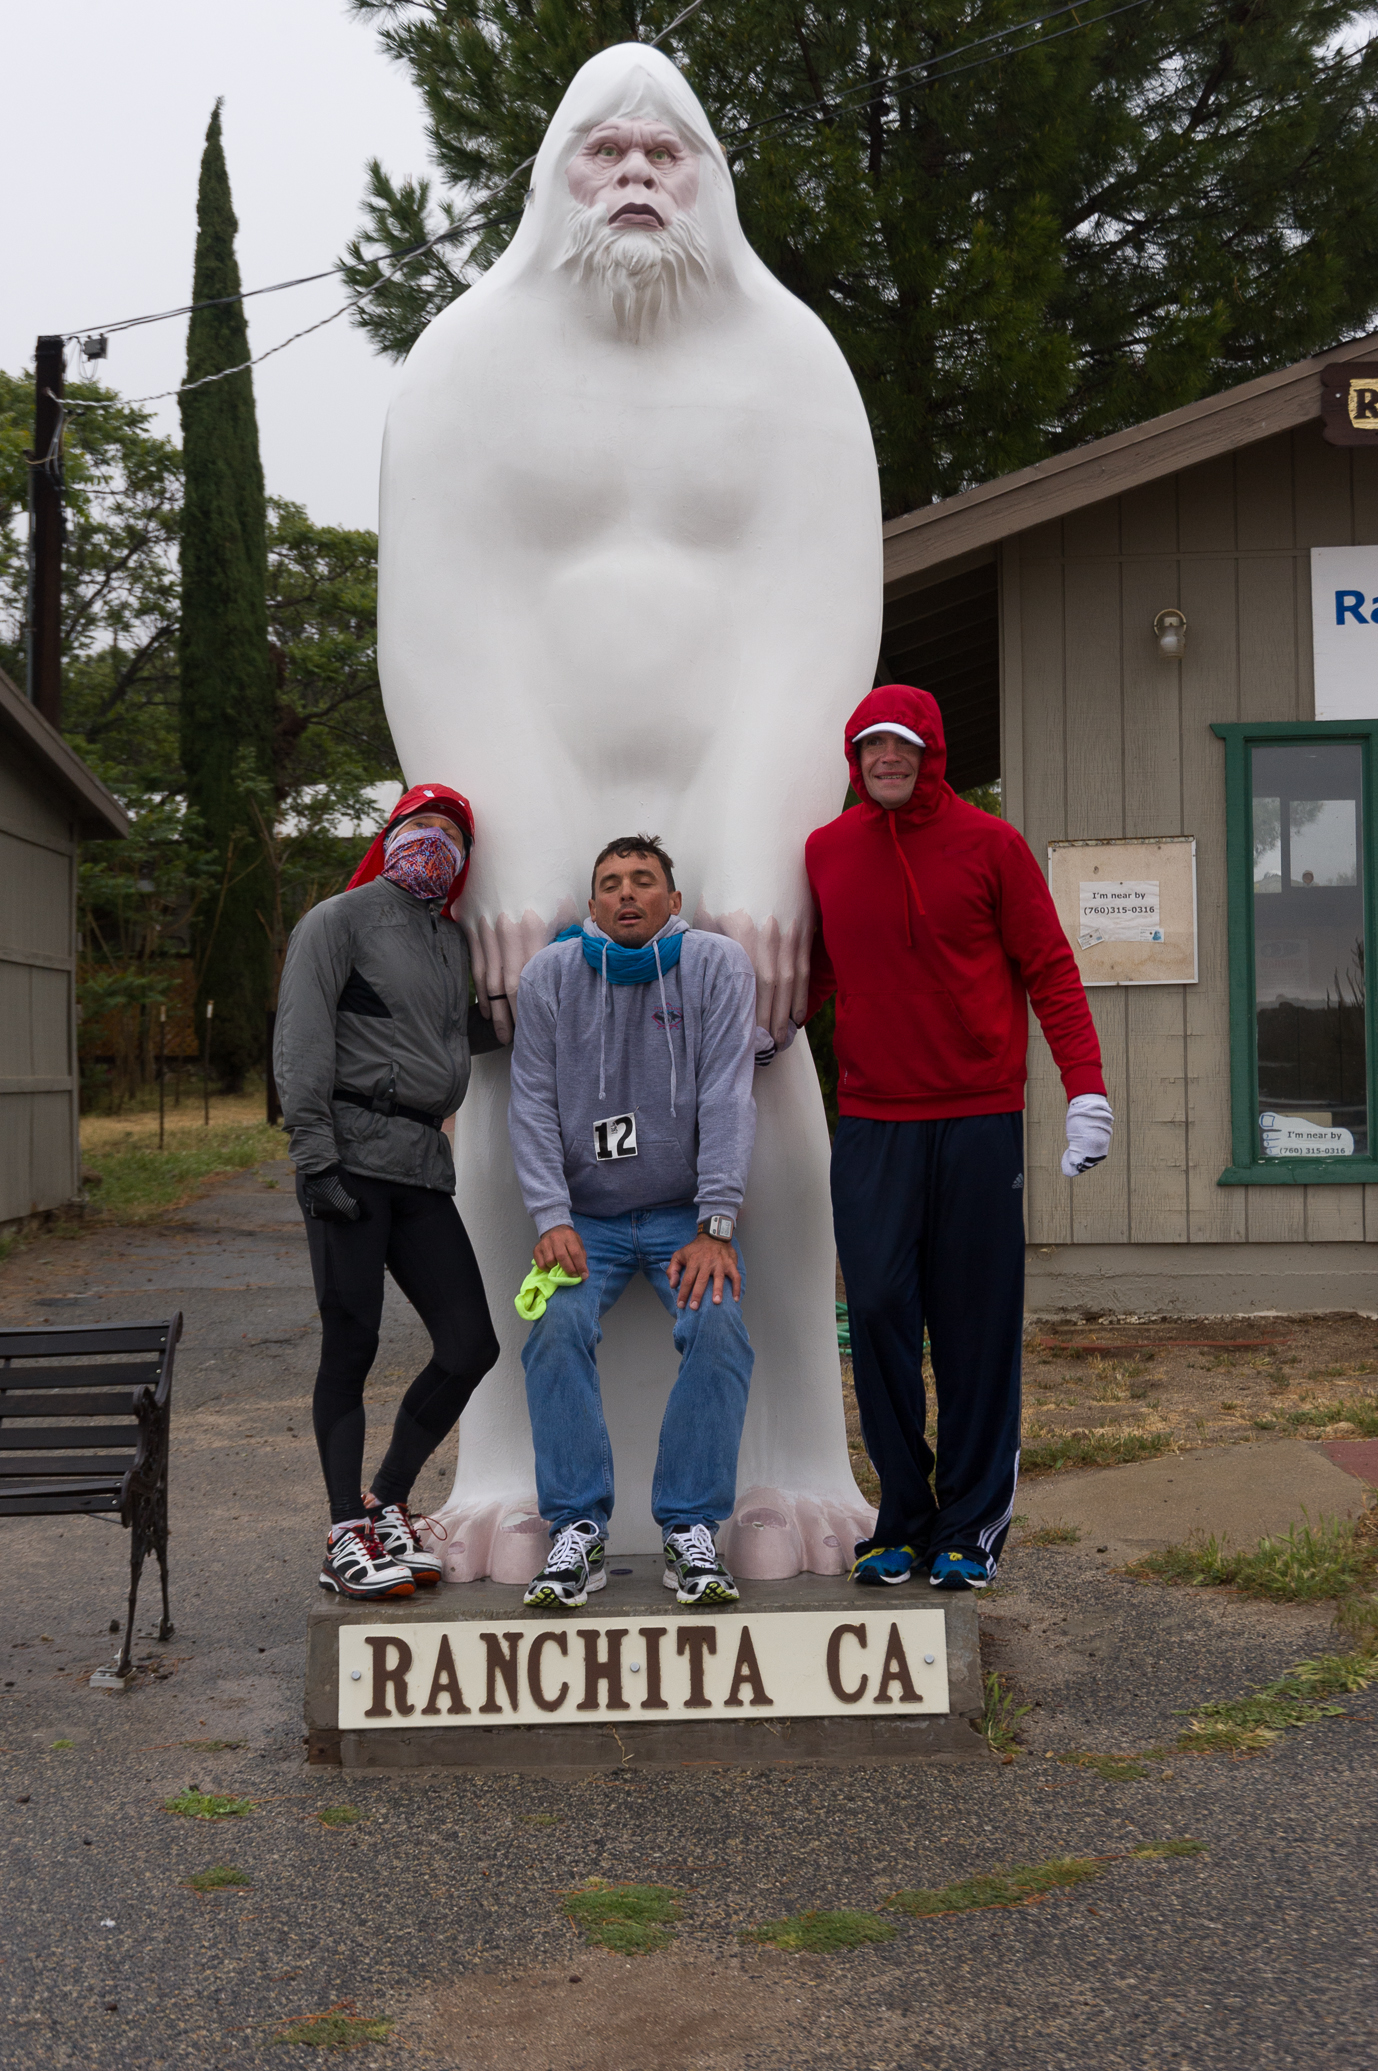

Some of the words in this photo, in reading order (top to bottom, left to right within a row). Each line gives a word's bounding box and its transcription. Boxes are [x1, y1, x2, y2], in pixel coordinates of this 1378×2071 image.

[1092, 892, 1108, 900] I'm
[1134, 891, 1146, 900] by
[1083, 906, 1155, 915] (760)315-0316
[594, 1116, 637, 1159] 12
[1287, 1131, 1303, 1139] I'm
[1330, 1131, 1342, 1140] by
[1279, 1147, 1303, 1155] (760)
[1305, 1147, 1346, 1155] 315-0316
[364, 1625, 774, 1718] RANCHITA
[826, 1622, 924, 1704] CA
